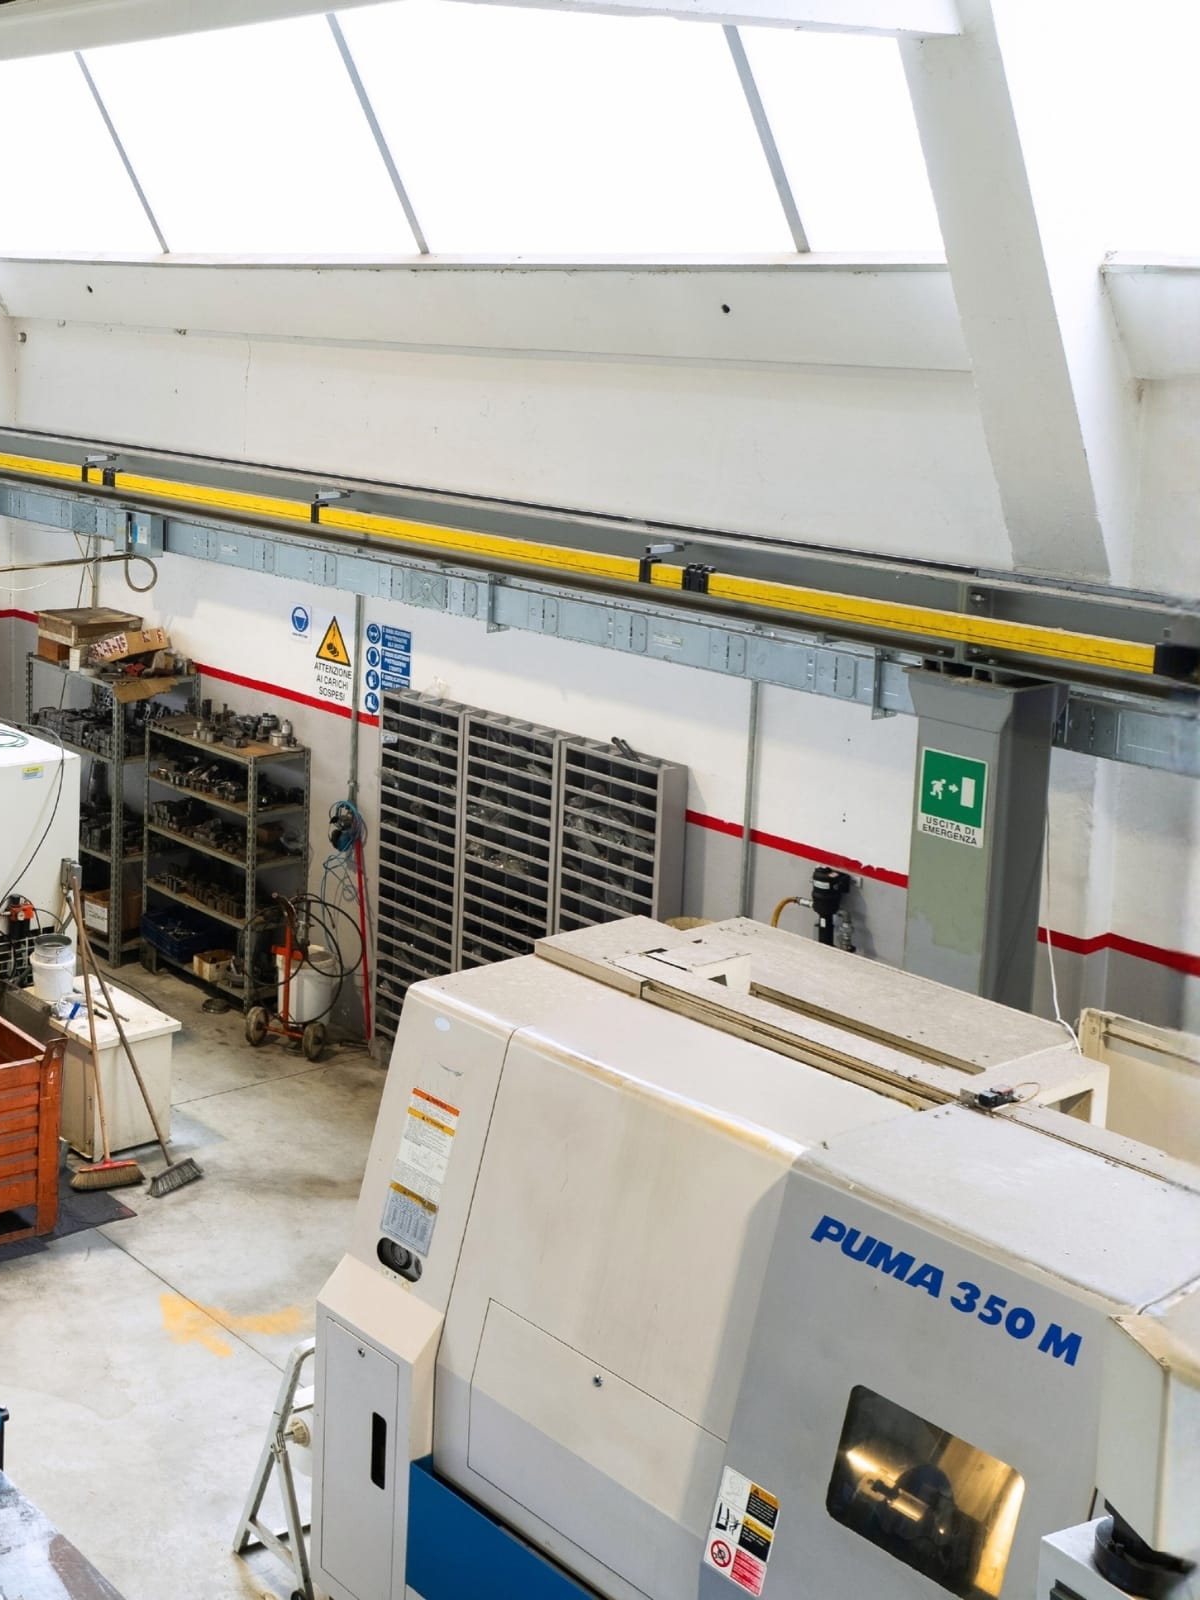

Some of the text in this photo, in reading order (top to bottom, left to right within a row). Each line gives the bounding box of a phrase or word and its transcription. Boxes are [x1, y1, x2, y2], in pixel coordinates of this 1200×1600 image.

[314, 662, 352, 680] ATTENZIONE
[316, 673, 349, 691] AI CARICHI
[319, 686, 346, 701] SOSPESI
[922, 823, 977, 845] EMERGENZA
[926, 816, 975, 836] USCITA DI
[810, 1215, 1082, 1366] PUMA 350 M
